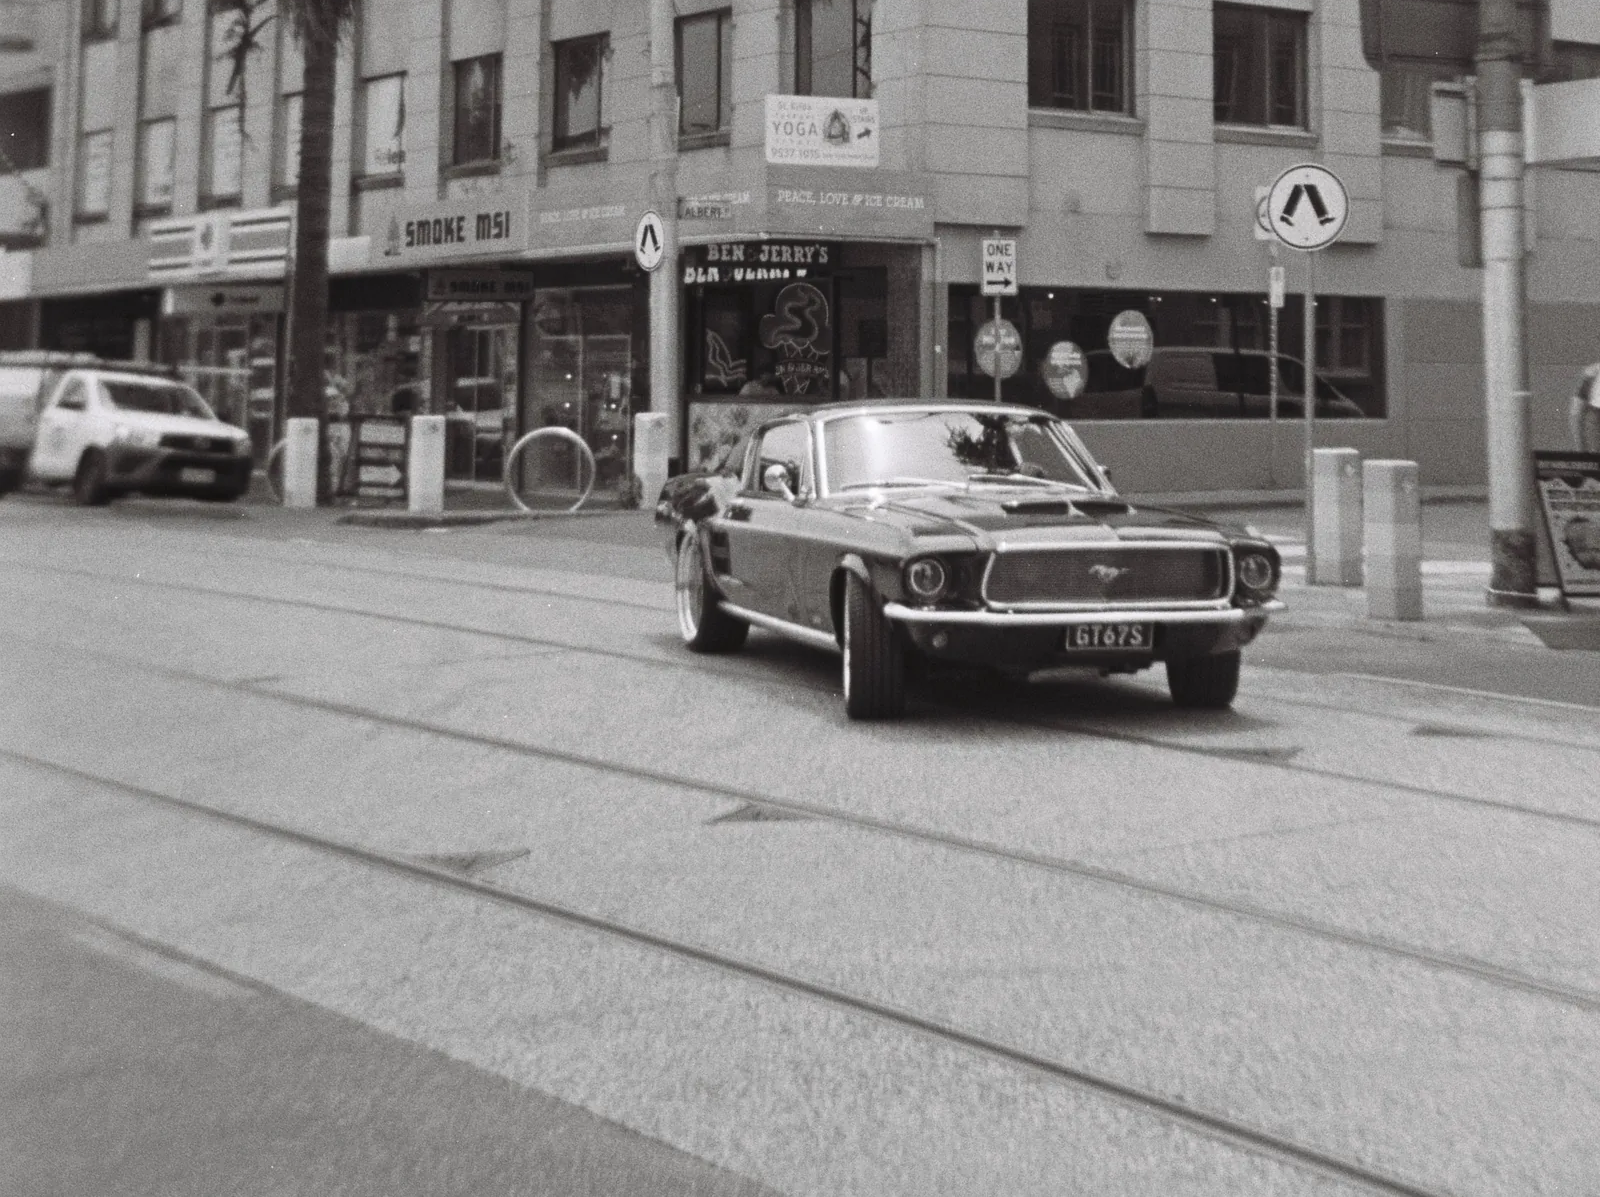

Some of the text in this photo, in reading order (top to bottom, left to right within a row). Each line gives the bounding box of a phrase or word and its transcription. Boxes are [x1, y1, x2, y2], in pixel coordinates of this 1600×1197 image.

[772, 121, 819, 137] YOGA
[778, 189, 816, 205] PEACE,
[820, 192, 849, 205] LOVE
[865, 195, 882, 207] ICE
[887, 196, 925, 208] CREAM
[405, 215, 466, 247] SMOKE
[476, 211, 510, 241] MSI
[707, 244, 745, 262] BEN
[759, 245, 829, 263] JERRY'S
[986, 244, 1012, 256] ONE
[986, 261, 1013, 274] WAY
[1076, 625, 1143, 645] GT67S
